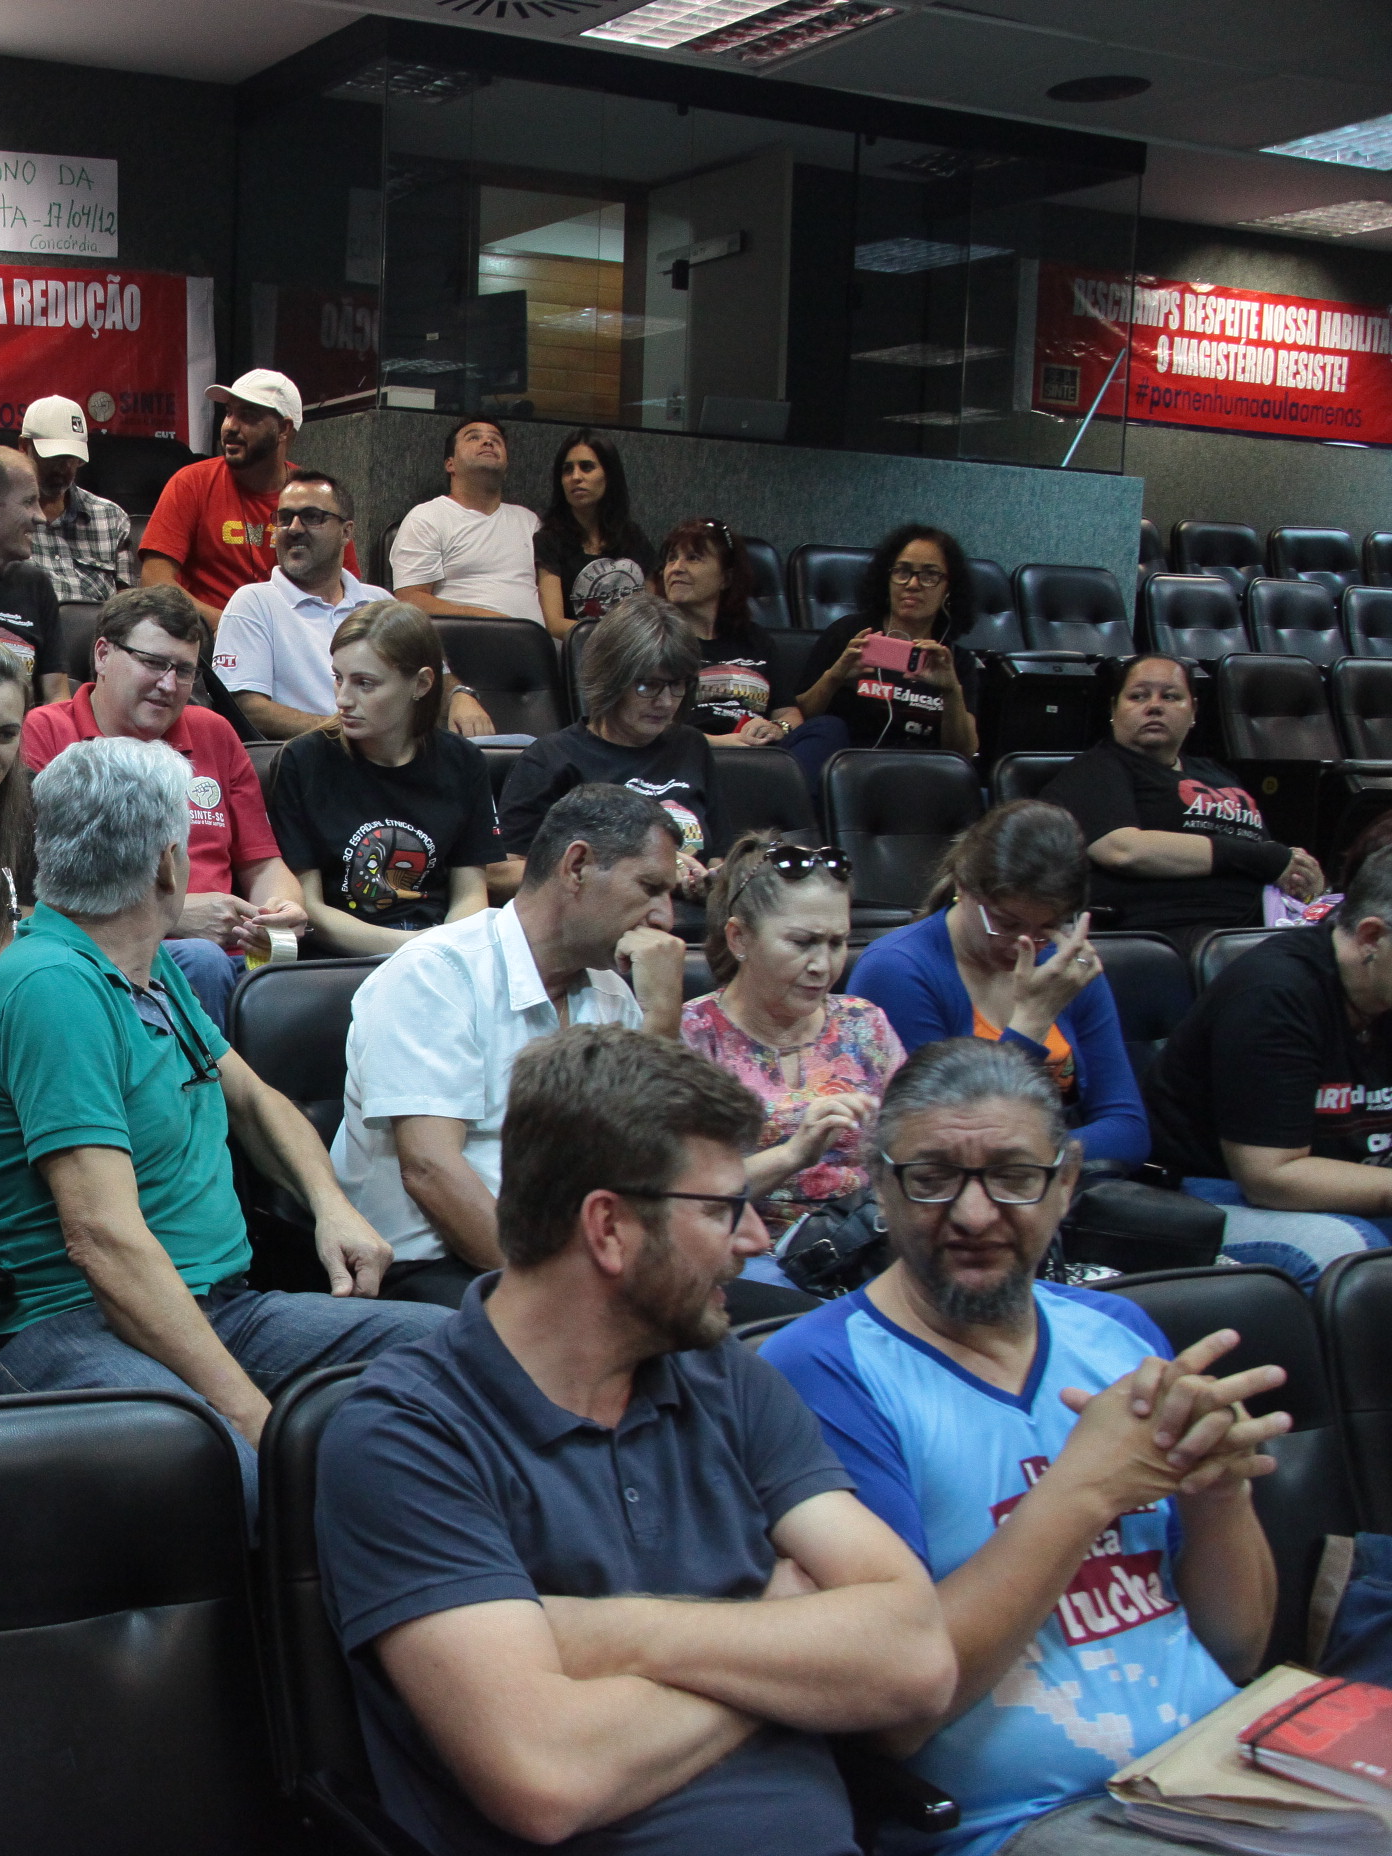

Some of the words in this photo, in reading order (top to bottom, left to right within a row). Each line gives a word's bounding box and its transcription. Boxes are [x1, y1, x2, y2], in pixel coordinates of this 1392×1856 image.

[58, 164, 95, 190] DA
[13, 274, 141, 339] REDUÇÃO
[1184, 293, 1260, 338] RESPEITE
[1262, 303, 1318, 346] NOSSA
[1319, 311, 1392, 355] HABILITA
[1156, 335, 1170, 374] O
[1172, 339, 1274, 386] MAGISTÉRIO
[1276, 349, 1349, 393] RESISTE!
